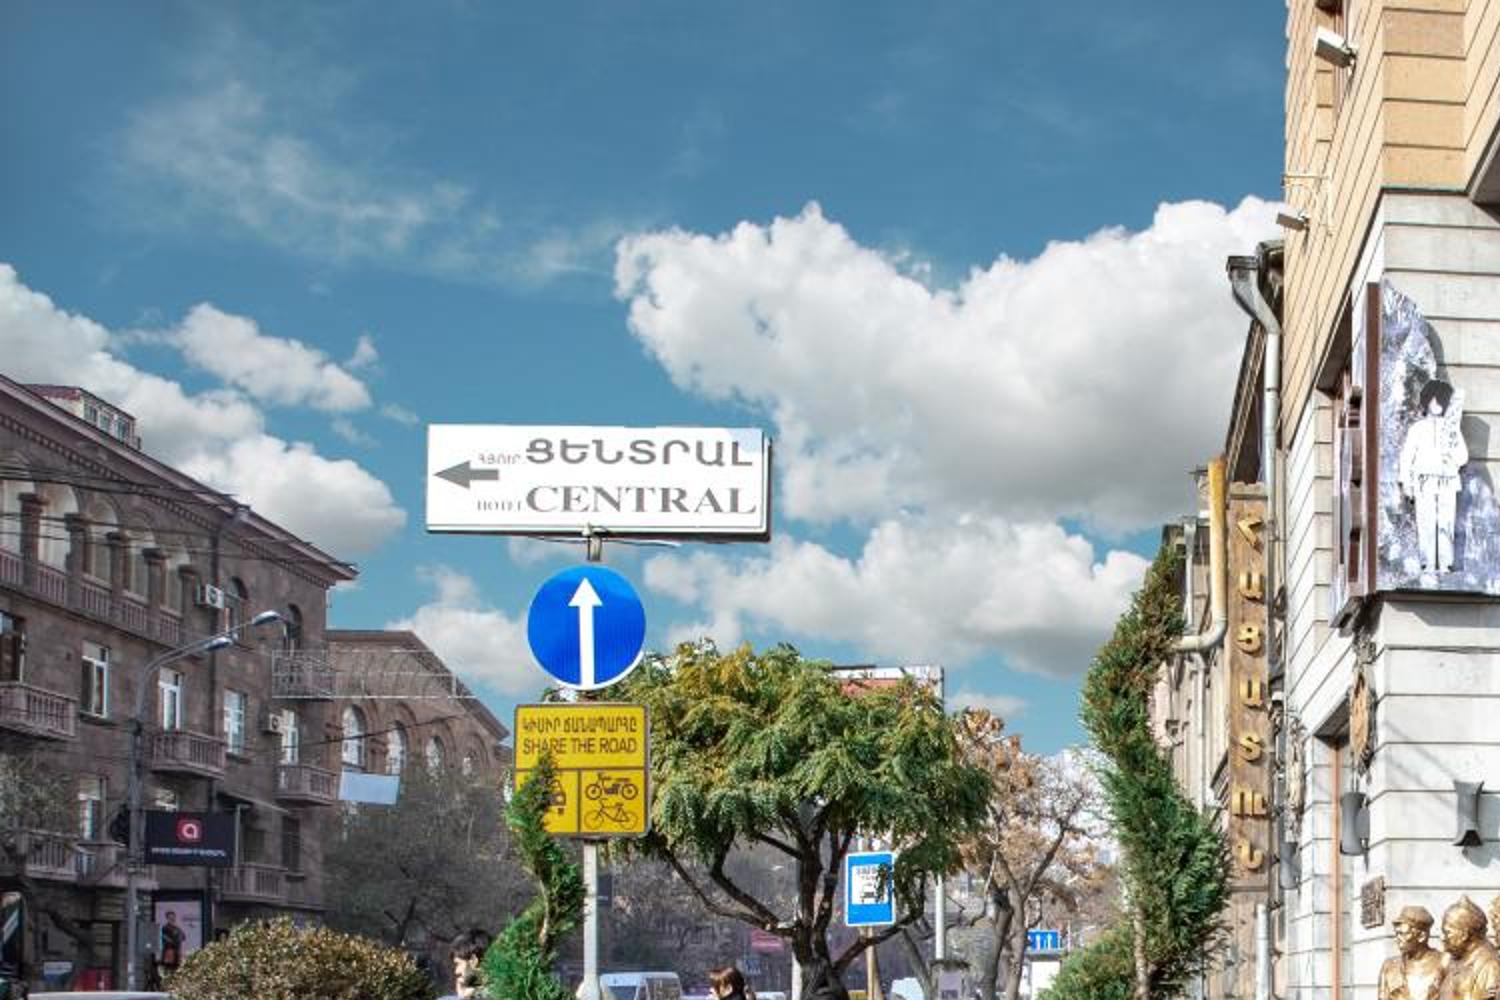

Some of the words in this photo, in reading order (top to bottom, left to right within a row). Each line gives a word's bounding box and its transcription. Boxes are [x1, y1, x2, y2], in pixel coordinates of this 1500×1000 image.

[526, 438, 753, 467] ՑԵՆՏՐԱԼ
[525, 485, 757, 514] CENTRAL
[523, 737, 567, 755] SHARE
[570, 737, 596, 754] THE
[599, 737, 638, 754] ROAD
